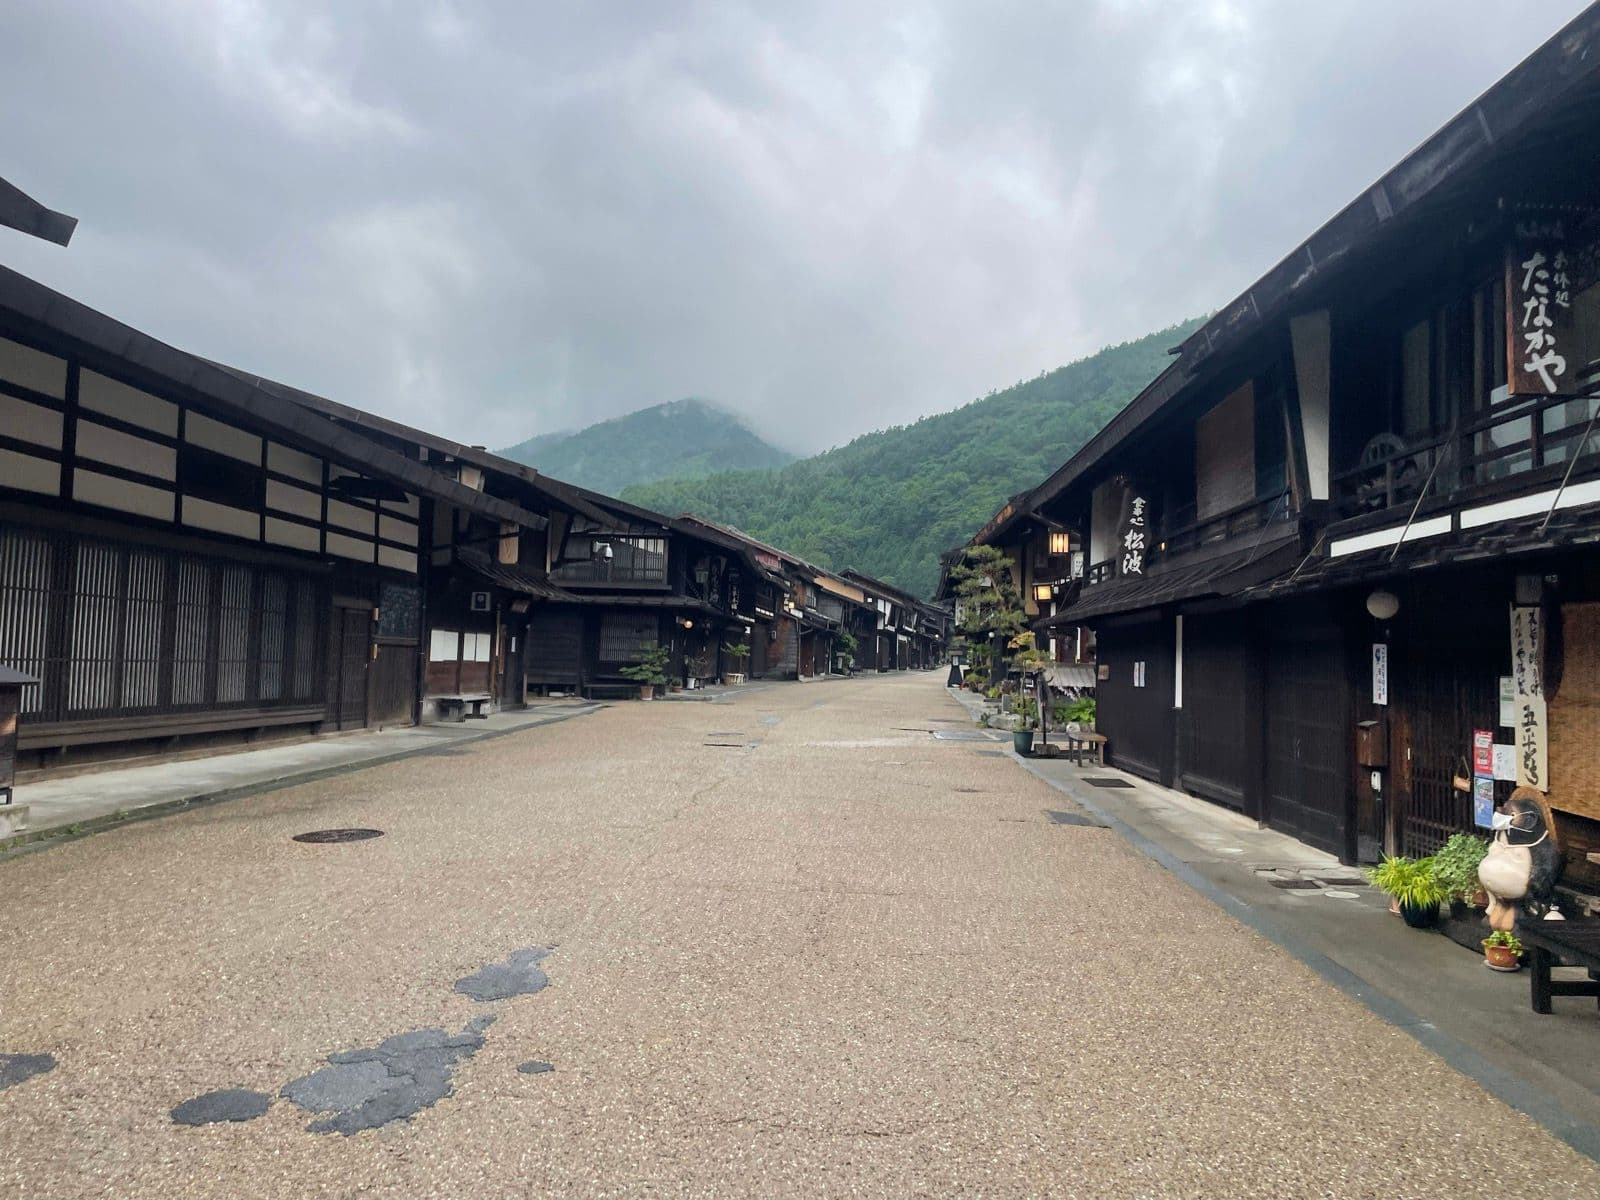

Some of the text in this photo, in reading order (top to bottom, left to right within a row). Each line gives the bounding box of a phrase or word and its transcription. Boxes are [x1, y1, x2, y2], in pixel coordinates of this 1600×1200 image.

[1521, 251, 1566, 394] たなかや
[1122, 528, 1145, 575] 松波
